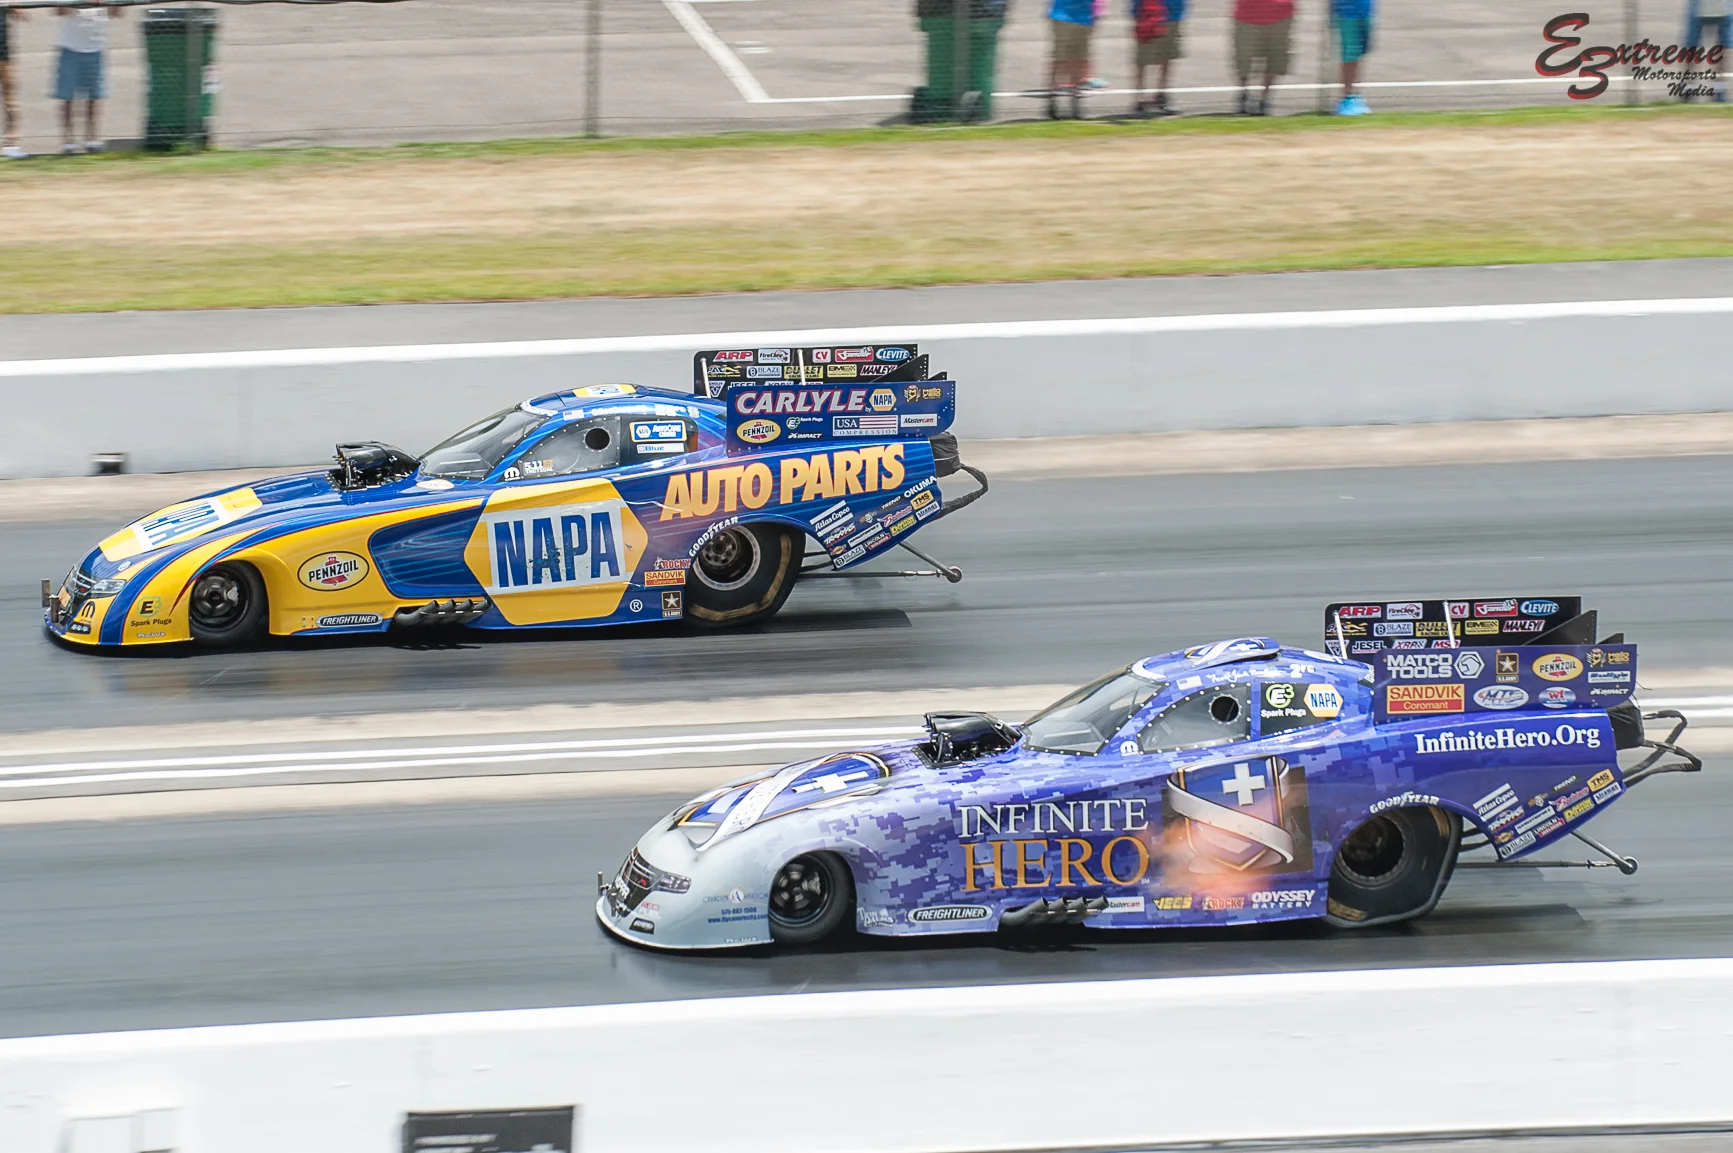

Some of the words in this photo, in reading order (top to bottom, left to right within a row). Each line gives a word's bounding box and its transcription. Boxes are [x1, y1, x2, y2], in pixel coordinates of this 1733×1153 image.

[716, 352, 752, 360] ARP
[815, 351, 828, 360] CV
[876, 348, 910, 360] CLEVITE
[757, 366, 780, 374] BLAZE
[736, 389, 868, 414] CARLYLE
[873, 394, 893, 406] NAPA
[836, 418, 858, 428] USA
[742, 425, 776, 437] PENNZOIL
[659, 462, 773, 522] AUTO
[780, 443, 905, 505] PARTS
[904, 476, 938, 498] OKUMA
[912, 493, 930, 505] TMS
[815, 517, 832, 532] Atlas
[831, 507, 850, 521] Copco
[494, 512, 620, 588] NAPA
[664, 559, 692, 569] ROCKY
[308, 560, 359, 582] PENNZOIL
[646, 570, 684, 580] SANDVIK
[1338, 607, 1380, 616] ARP
[1451, 605, 1466, 614] CV
[1520, 601, 1559, 614] CLEVITE
[130, 620, 150, 628] Spark
[322, 615, 376, 625] FREIGHTLINER
[1504, 620, 1538, 632] MANLEY
[1387, 623, 1412, 631] BLAZE
[1353, 640, 1386, 650] JESEL
[1396, 641, 1418, 649] XRP
[1387, 654, 1453, 666] MATCO
[1387, 666, 1453, 678] TOOLS
[1539, 660, 1577, 673] PENNZOIL
[1390, 686, 1462, 699] SANDVIK
[1310, 692, 1338, 708] NAPA
[1403, 701, 1449, 710] Coromant
[1260, 708, 1284, 718] Spark
[1285, 708, 1306, 718] Plugs
[1414, 724, 1600, 754] InfiniteHero.Org
[1554, 775, 1576, 791] TREND
[1591, 772, 1610, 786] TMS
[1370, 790, 1440, 814] GOODYEAR
[1478, 802, 1497, 815] Atlas
[1495, 790, 1515, 805] Copco
[957, 798, 1149, 838] INFINITE
[959, 836, 1149, 893] HERO
[1251, 889, 1316, 902] ODYSSEY
[1212, 897, 1244, 910] ROCKY
[1252, 902, 1313, 910] BATTERY
[916, 908, 985, 920] FREIGHTLINER
